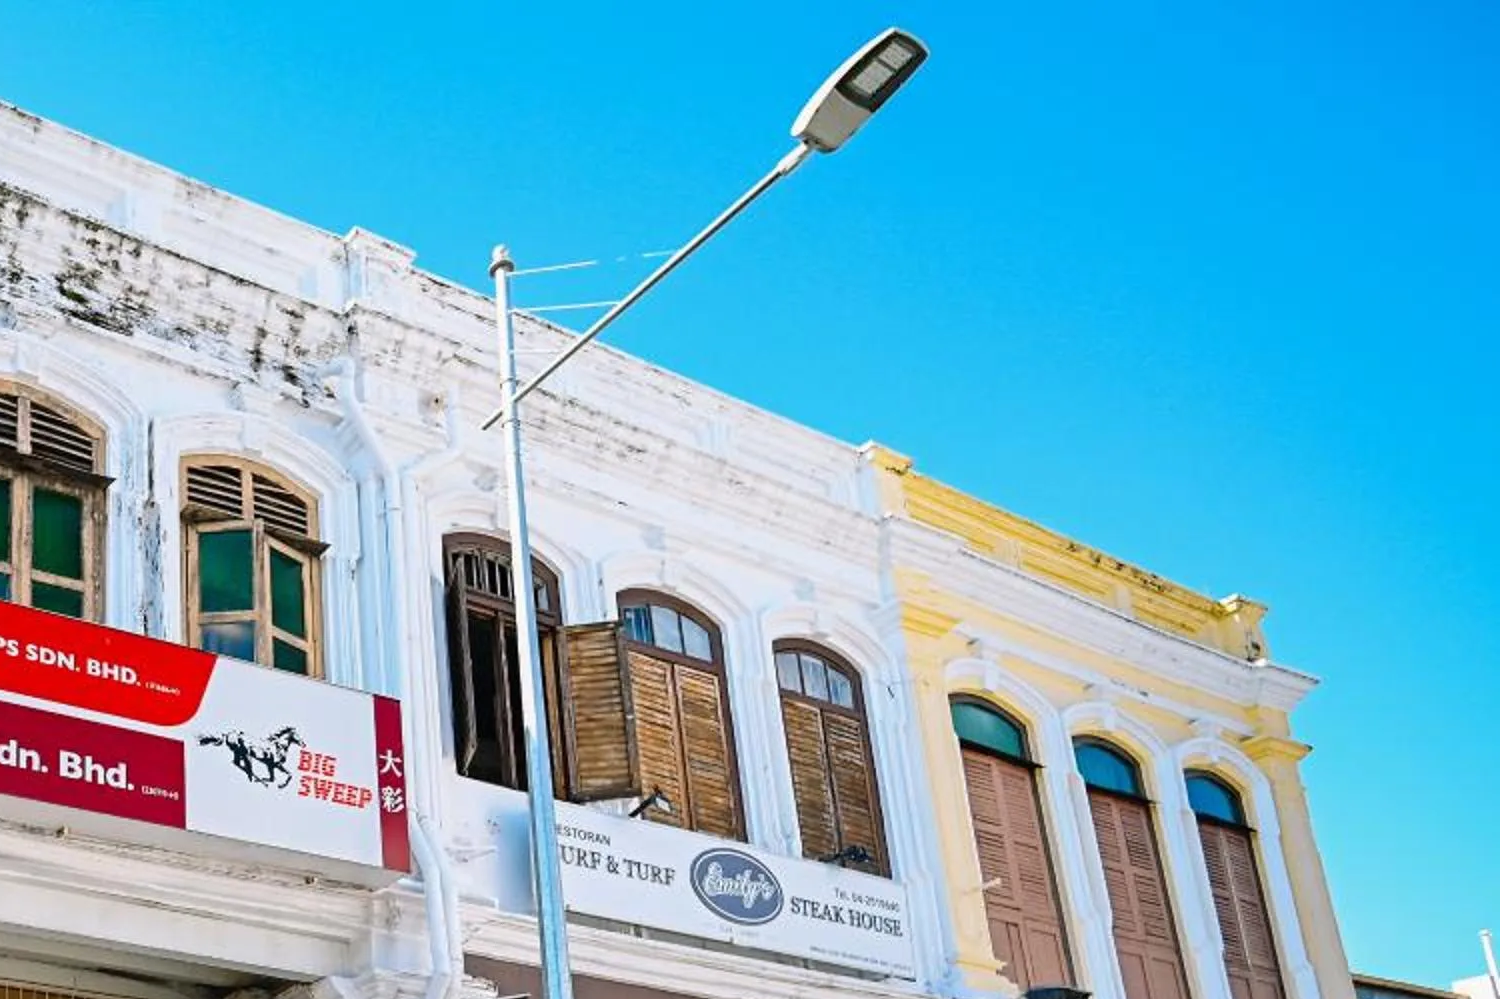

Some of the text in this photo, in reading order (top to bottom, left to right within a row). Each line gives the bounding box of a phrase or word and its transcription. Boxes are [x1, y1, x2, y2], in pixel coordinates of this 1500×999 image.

[25, 643, 81, 672] SDN.
[87, 658, 142, 687] BHD.
[59, 750, 135, 791] Bhd.
[298, 750, 337, 777] BIG
[379, 749, 404, 812] 大彩
[298, 776, 372, 809] SWEEP
[554, 824, 611, 846] ESTORAN
[560, 845, 676, 886] URF & TURF
[702, 861, 775, 909] Emily's
[790, 896, 845, 925] STEAK
[848, 909, 903, 937] HOUSE
